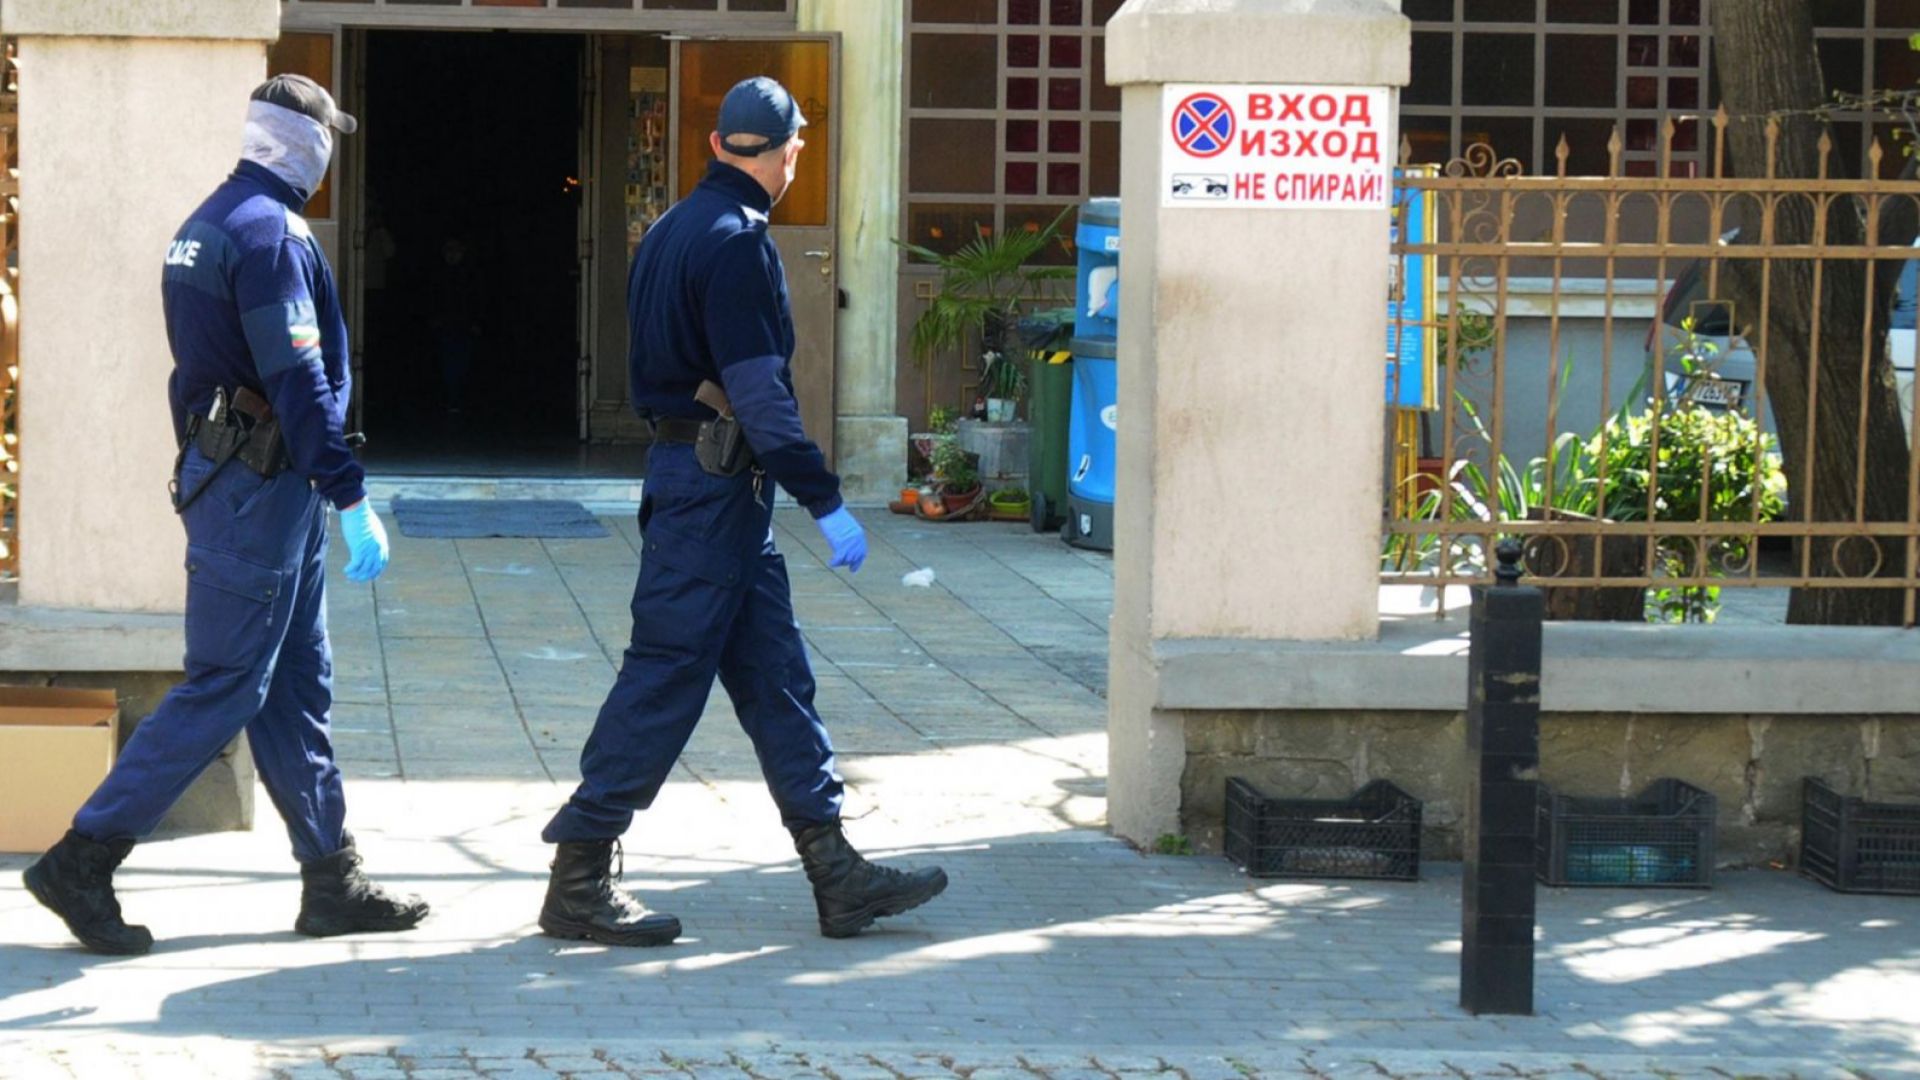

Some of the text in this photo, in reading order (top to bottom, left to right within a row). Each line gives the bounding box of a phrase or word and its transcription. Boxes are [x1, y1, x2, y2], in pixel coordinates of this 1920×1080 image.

[1247, 93, 1371, 127] ВХОД
[1240, 130, 1380, 163] ИЗХОД
[1235, 169, 1383, 201] НЕ СПИРАЙ!
